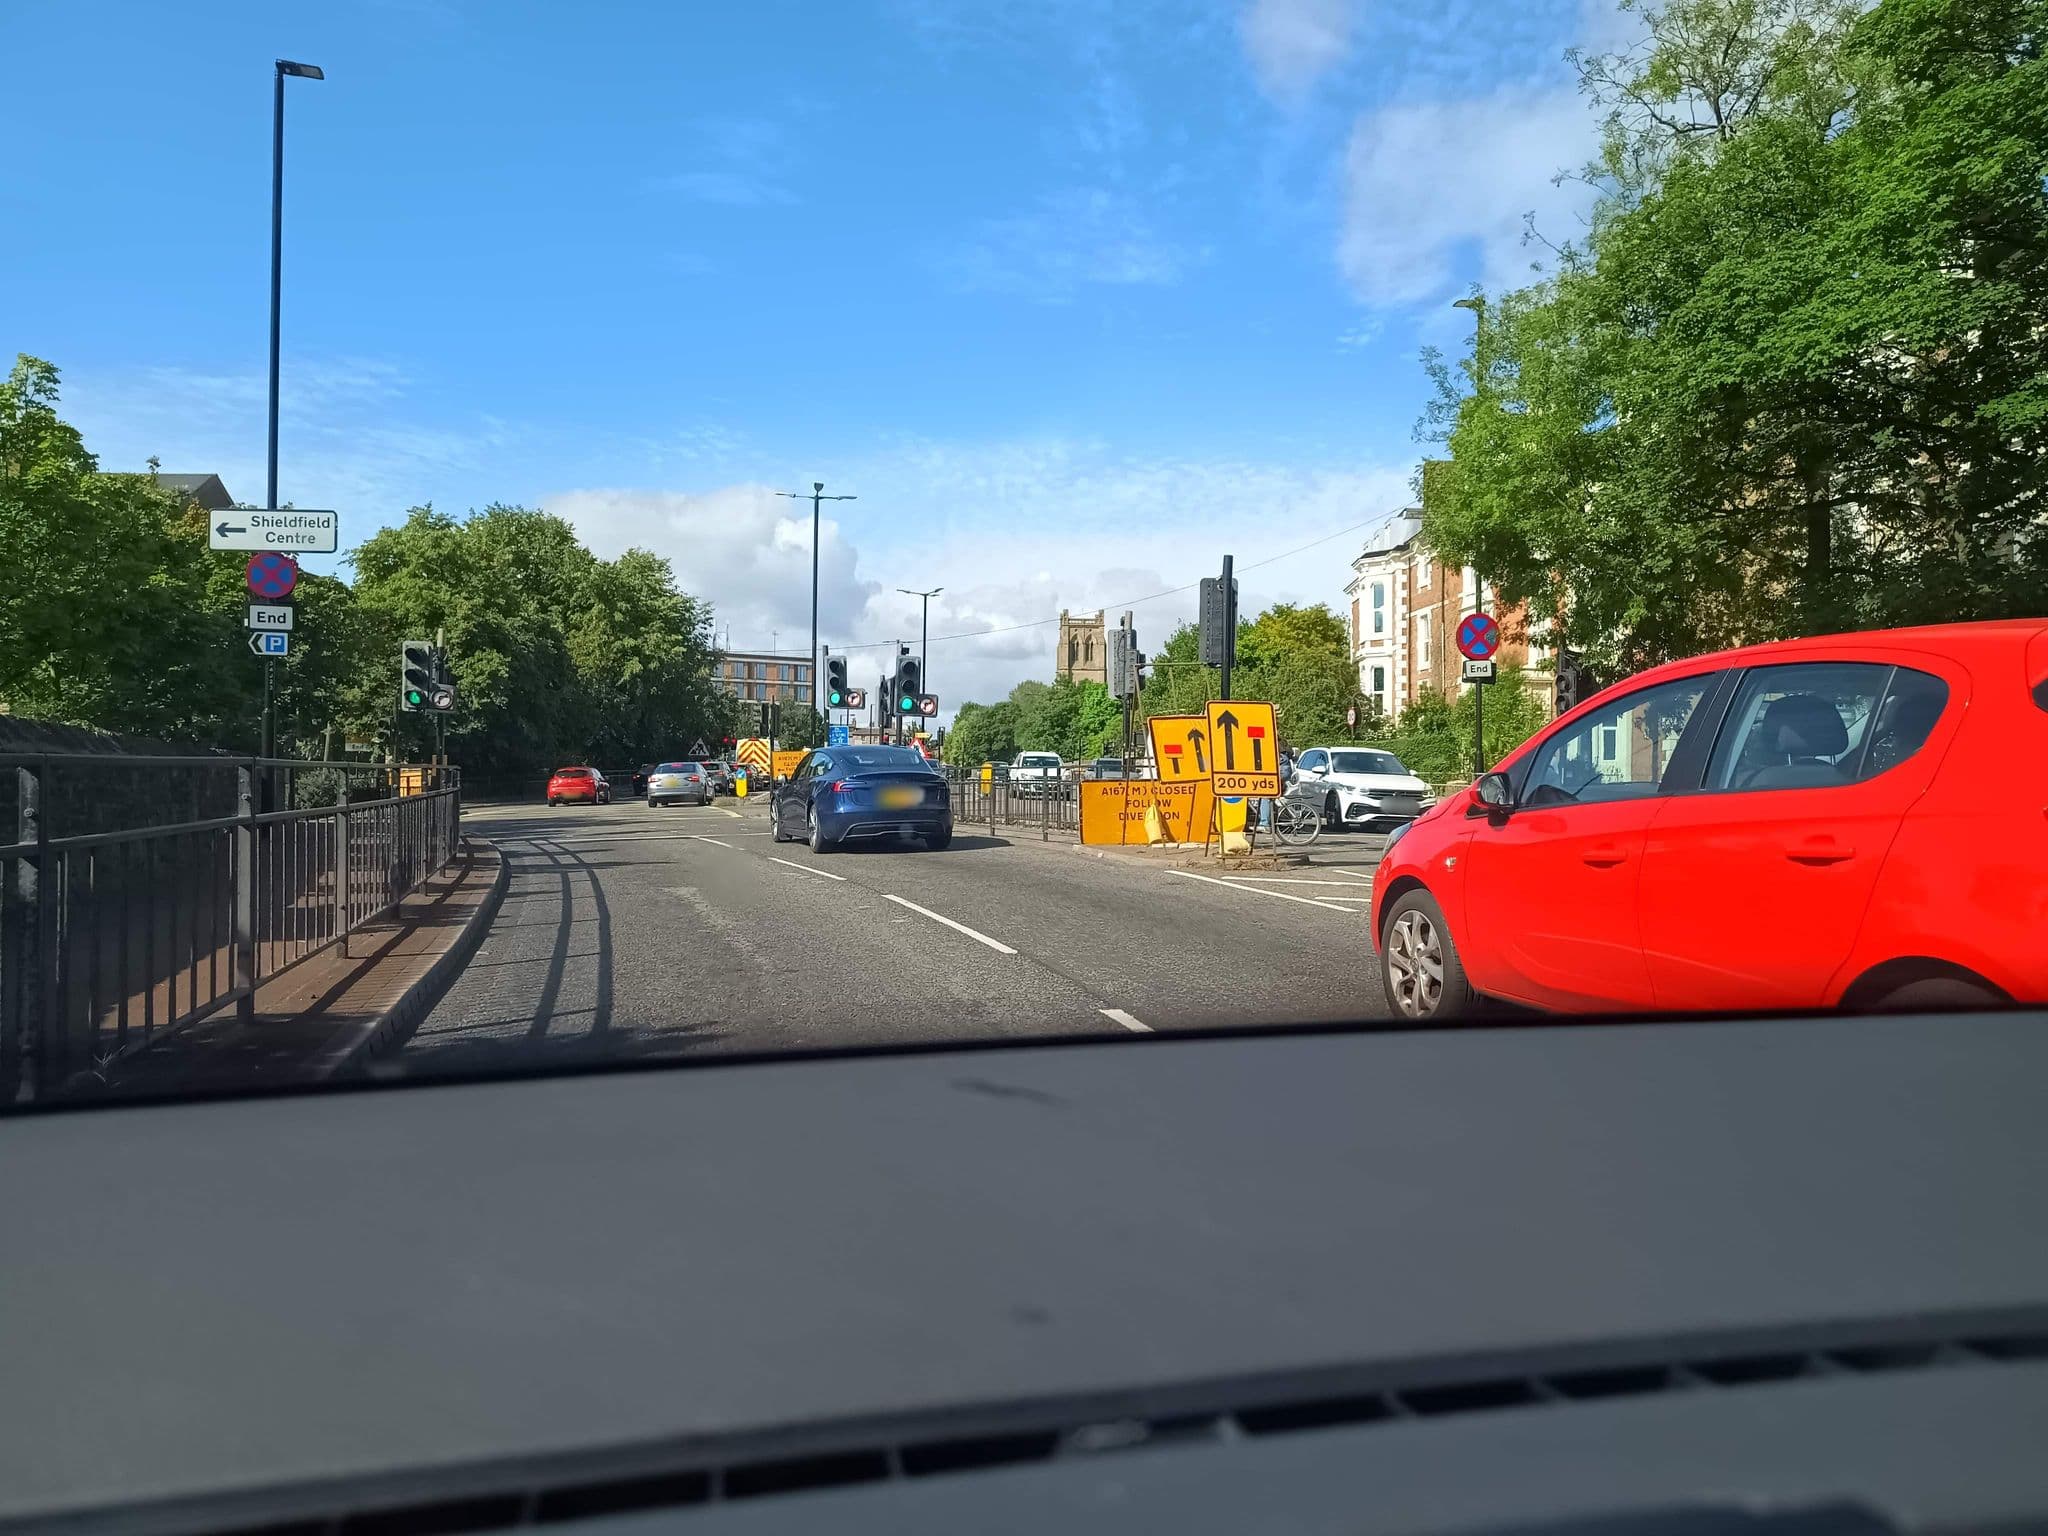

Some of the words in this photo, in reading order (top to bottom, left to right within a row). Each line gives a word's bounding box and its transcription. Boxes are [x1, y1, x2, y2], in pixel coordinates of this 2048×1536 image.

[251, 515, 330, 529] Shieldfield
[265, 531, 316, 544] Centre
[256, 611, 287, 624] End
[270, 637, 282, 651] P
[1470, 664, 1488, 673] End
[1217, 777, 1247, 789] 200
[1252, 777, 1275, 791] yds
[1151, 786, 1195, 796] CLOSED
